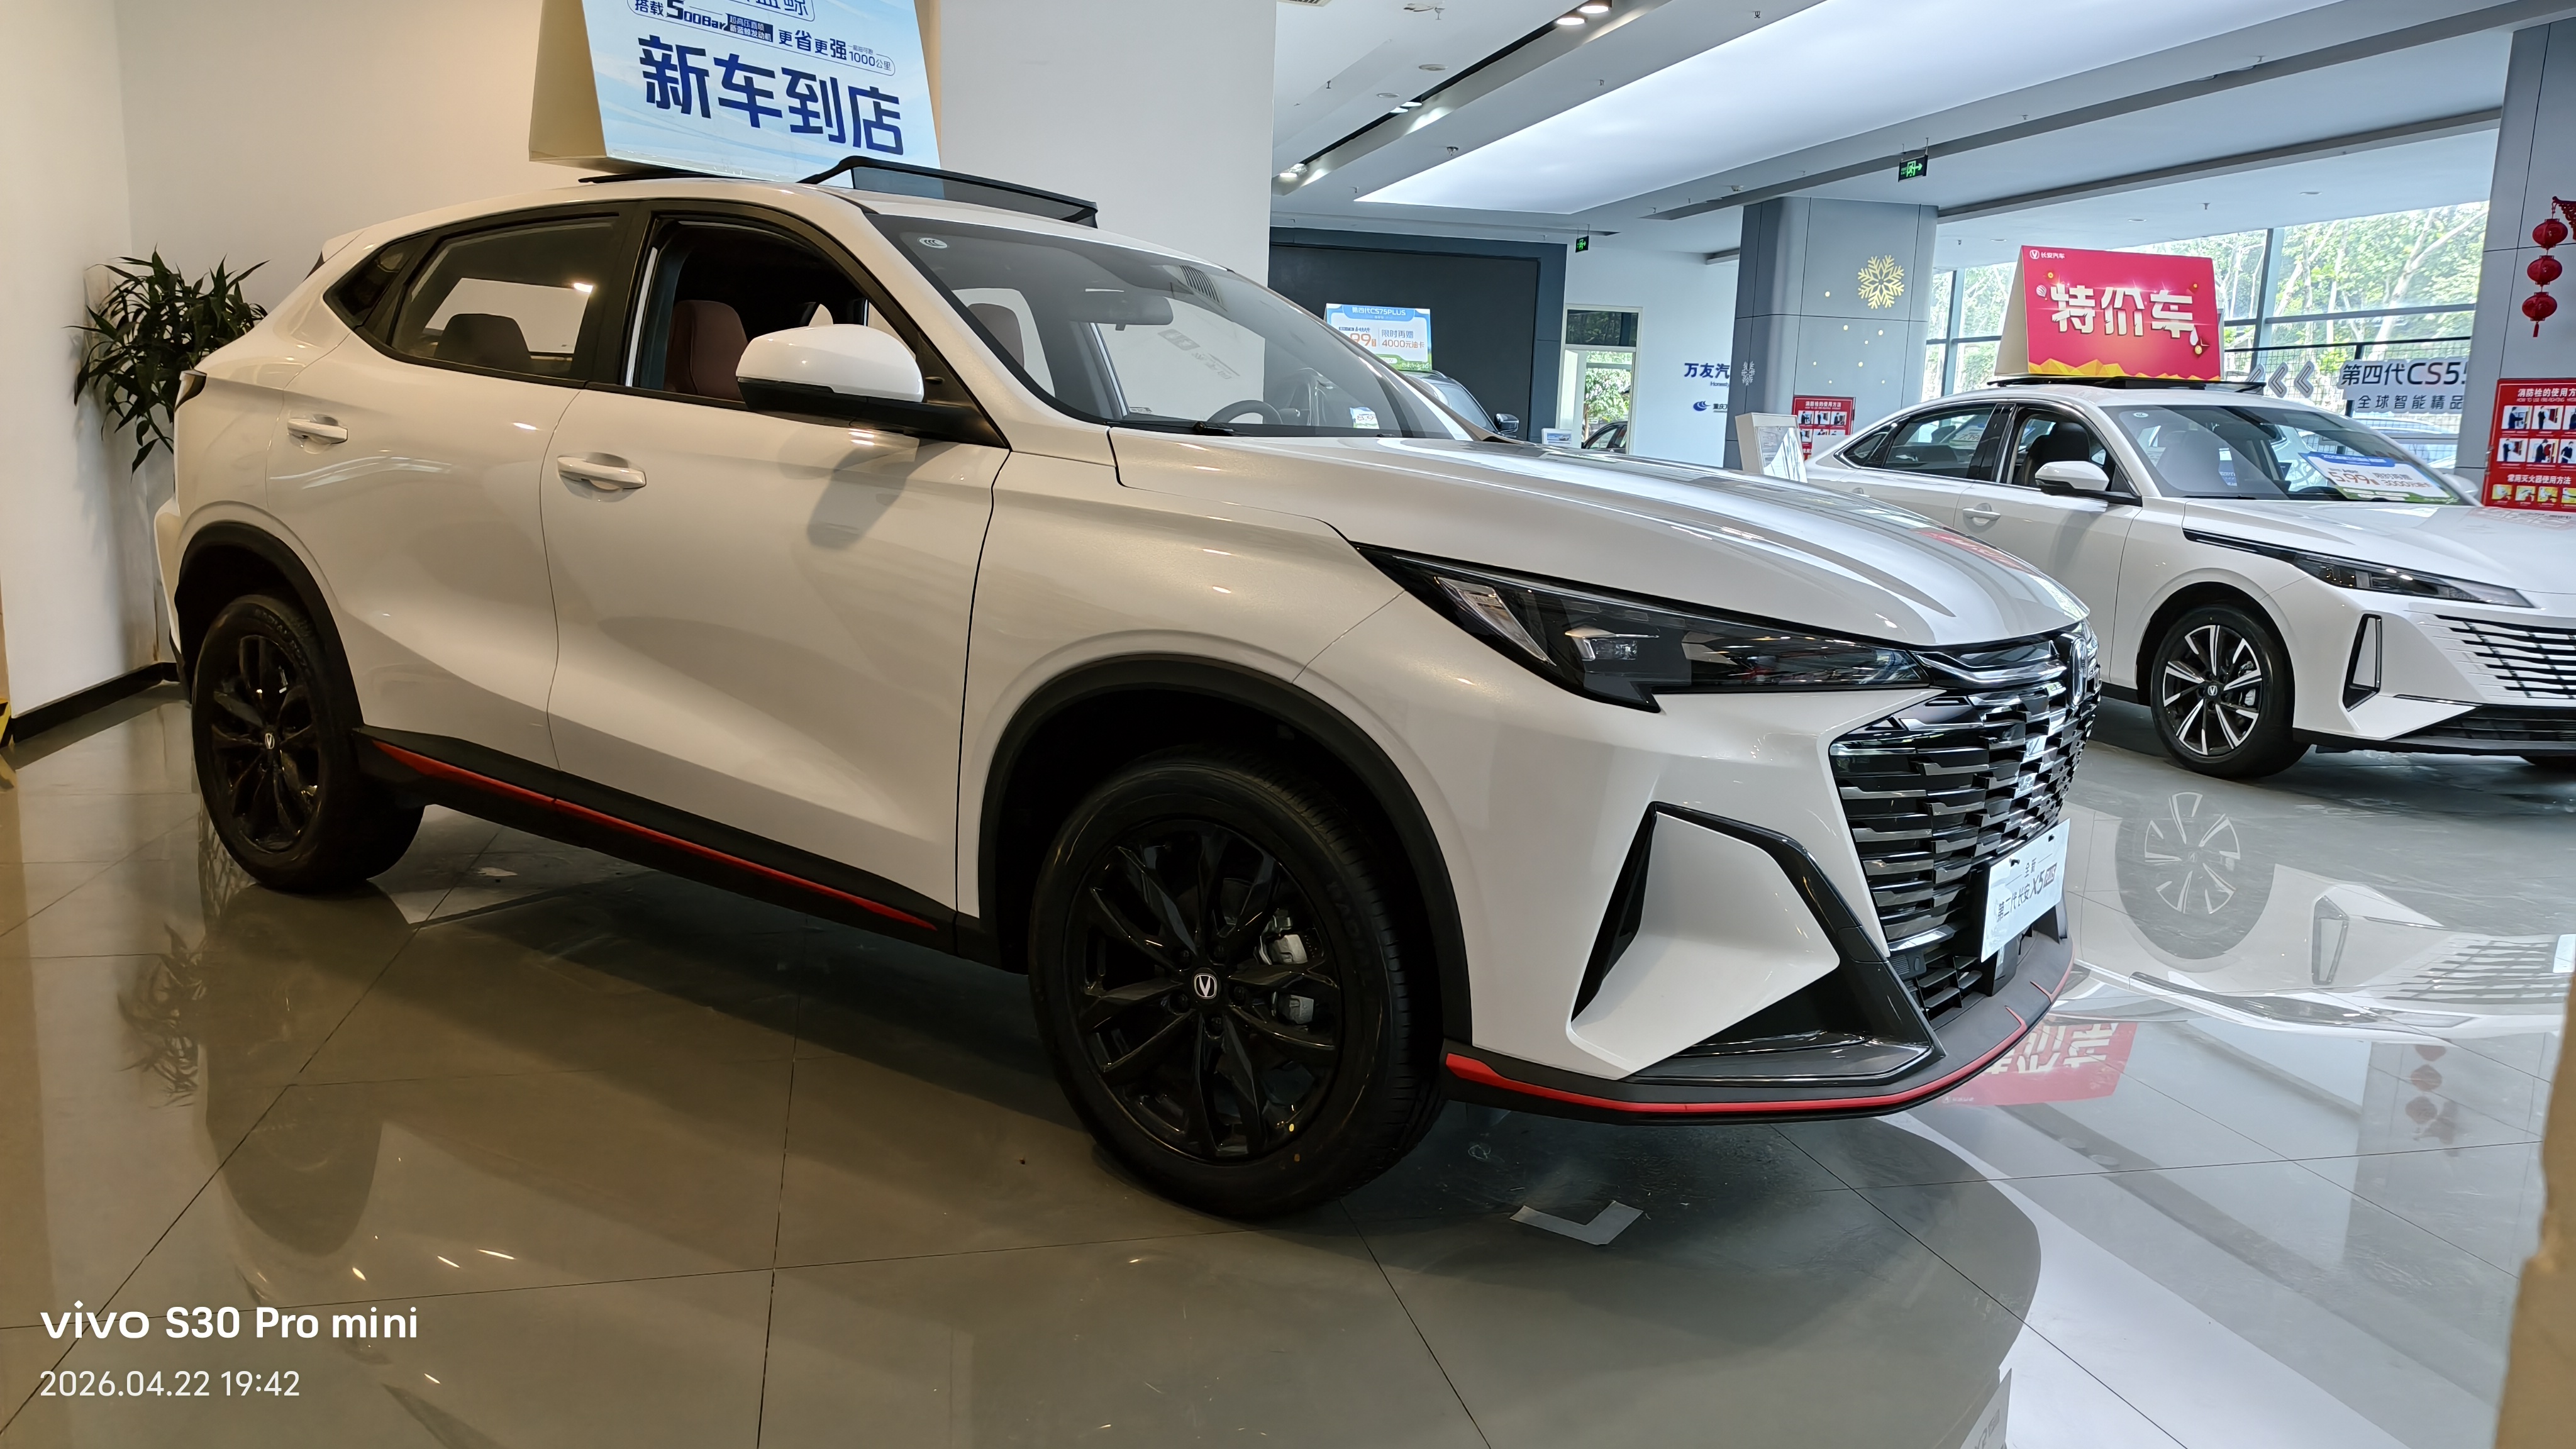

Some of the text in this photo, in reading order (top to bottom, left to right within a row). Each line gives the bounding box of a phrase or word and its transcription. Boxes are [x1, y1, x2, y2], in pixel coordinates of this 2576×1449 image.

[779, 30, 847, 60] 更省更强
[849, 51, 891, 71] 1000公里
[638, 35, 904, 155] 新车到店
[1352, 306, 1406, 316] 第四代CS75PLUS
[2050, 283, 2195, 338] 特价车
[1382, 330, 1414, 339] 限时再赠
[1382, 340, 1425, 348] 4000元油卡
[1684, 363, 1730, 379] 万友汽
[2341, 362, 2467, 386] 第四代CS5
[2358, 394, 2463, 410] 全球智能精品
[2328, 472, 2370, 484] 5.99
[2024, 857, 2037, 878] 全新
